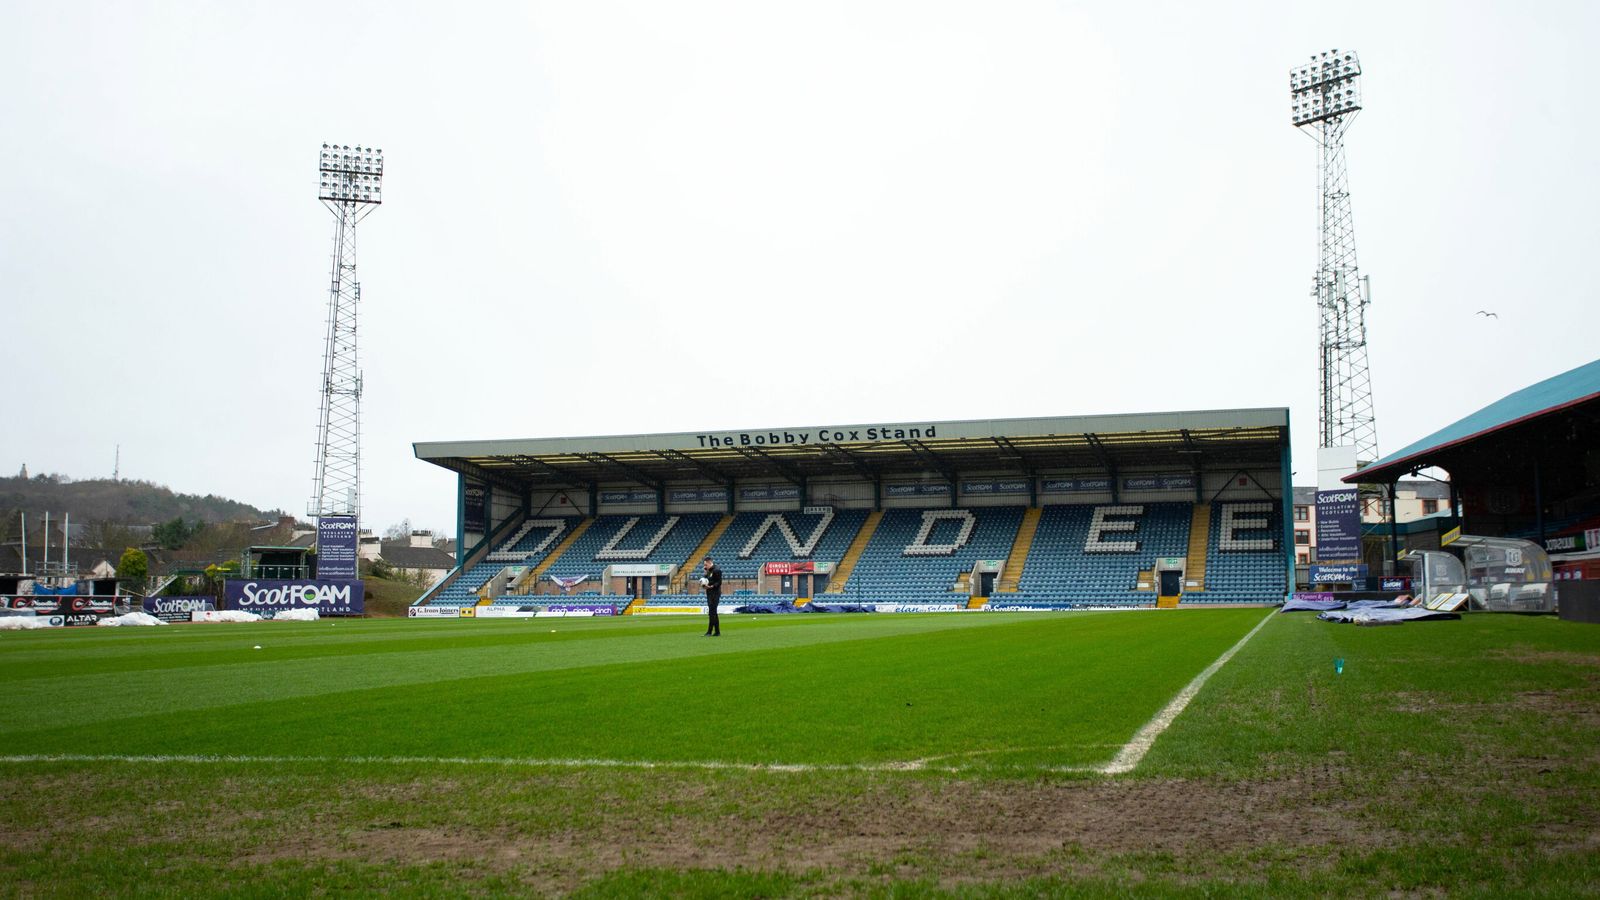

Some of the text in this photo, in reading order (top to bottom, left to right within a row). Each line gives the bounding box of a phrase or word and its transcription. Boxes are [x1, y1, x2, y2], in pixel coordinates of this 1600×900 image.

[697, 426, 937, 447] The Bobby Cox Stand
[1317, 492, 1357, 504] ScotFOAM
[320, 521, 356, 530] ScotFOAM
[1313, 573, 1346, 582] ScotFOAM
[238, 582, 351, 606] ScotFOAM
[153, 598, 206, 613] ScotFOAM
[594, 606, 612, 614] cinch
[66, 614, 98, 622] ALTAR
